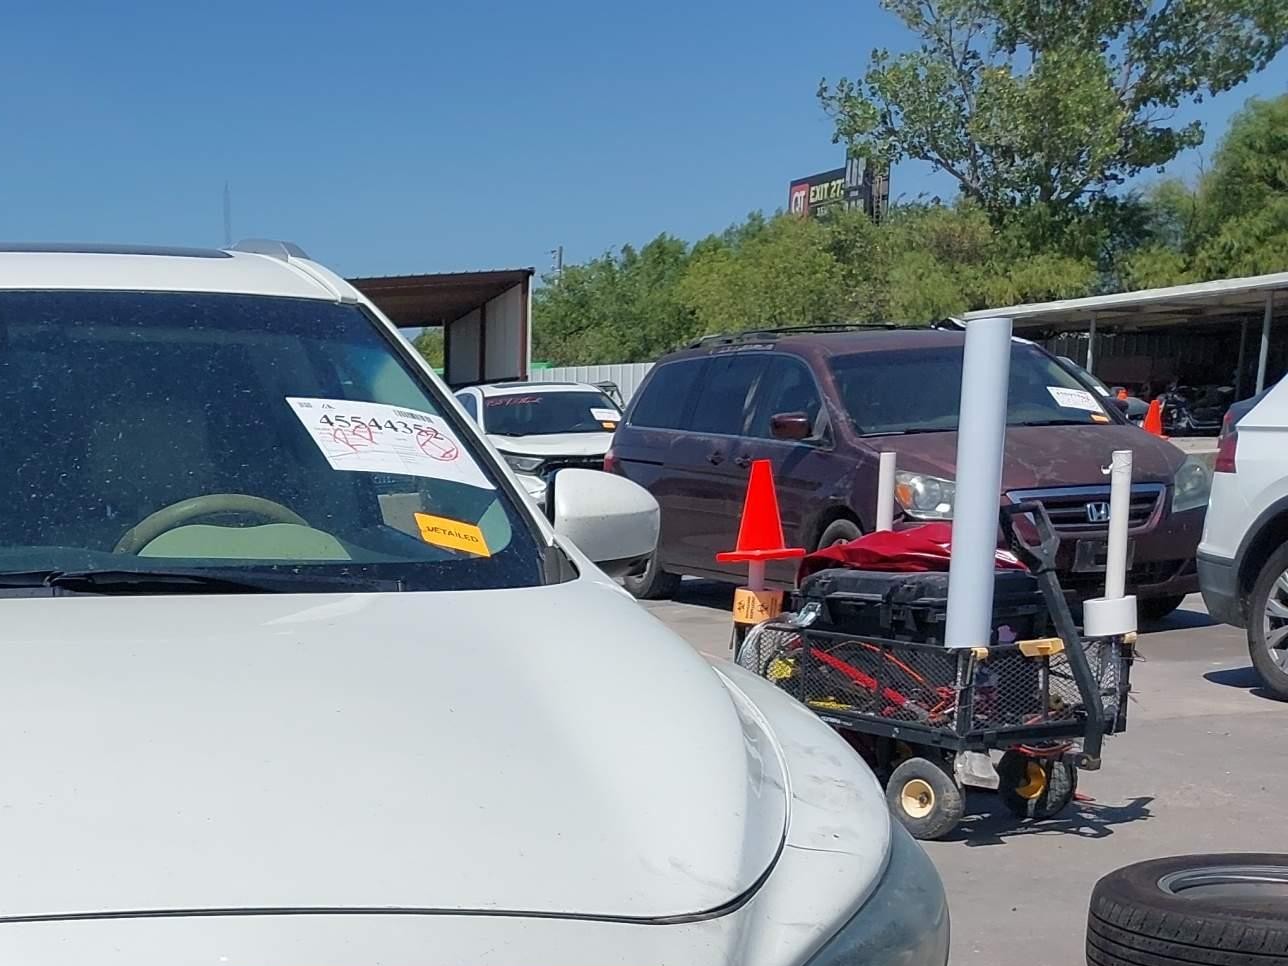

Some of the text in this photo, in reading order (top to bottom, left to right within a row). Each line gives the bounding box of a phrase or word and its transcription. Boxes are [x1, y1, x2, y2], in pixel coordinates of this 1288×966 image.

[810, 182, 830, 204] EXIT
[319, 414, 444, 441] 45544352
[426, 526, 479, 543] DETAILED
